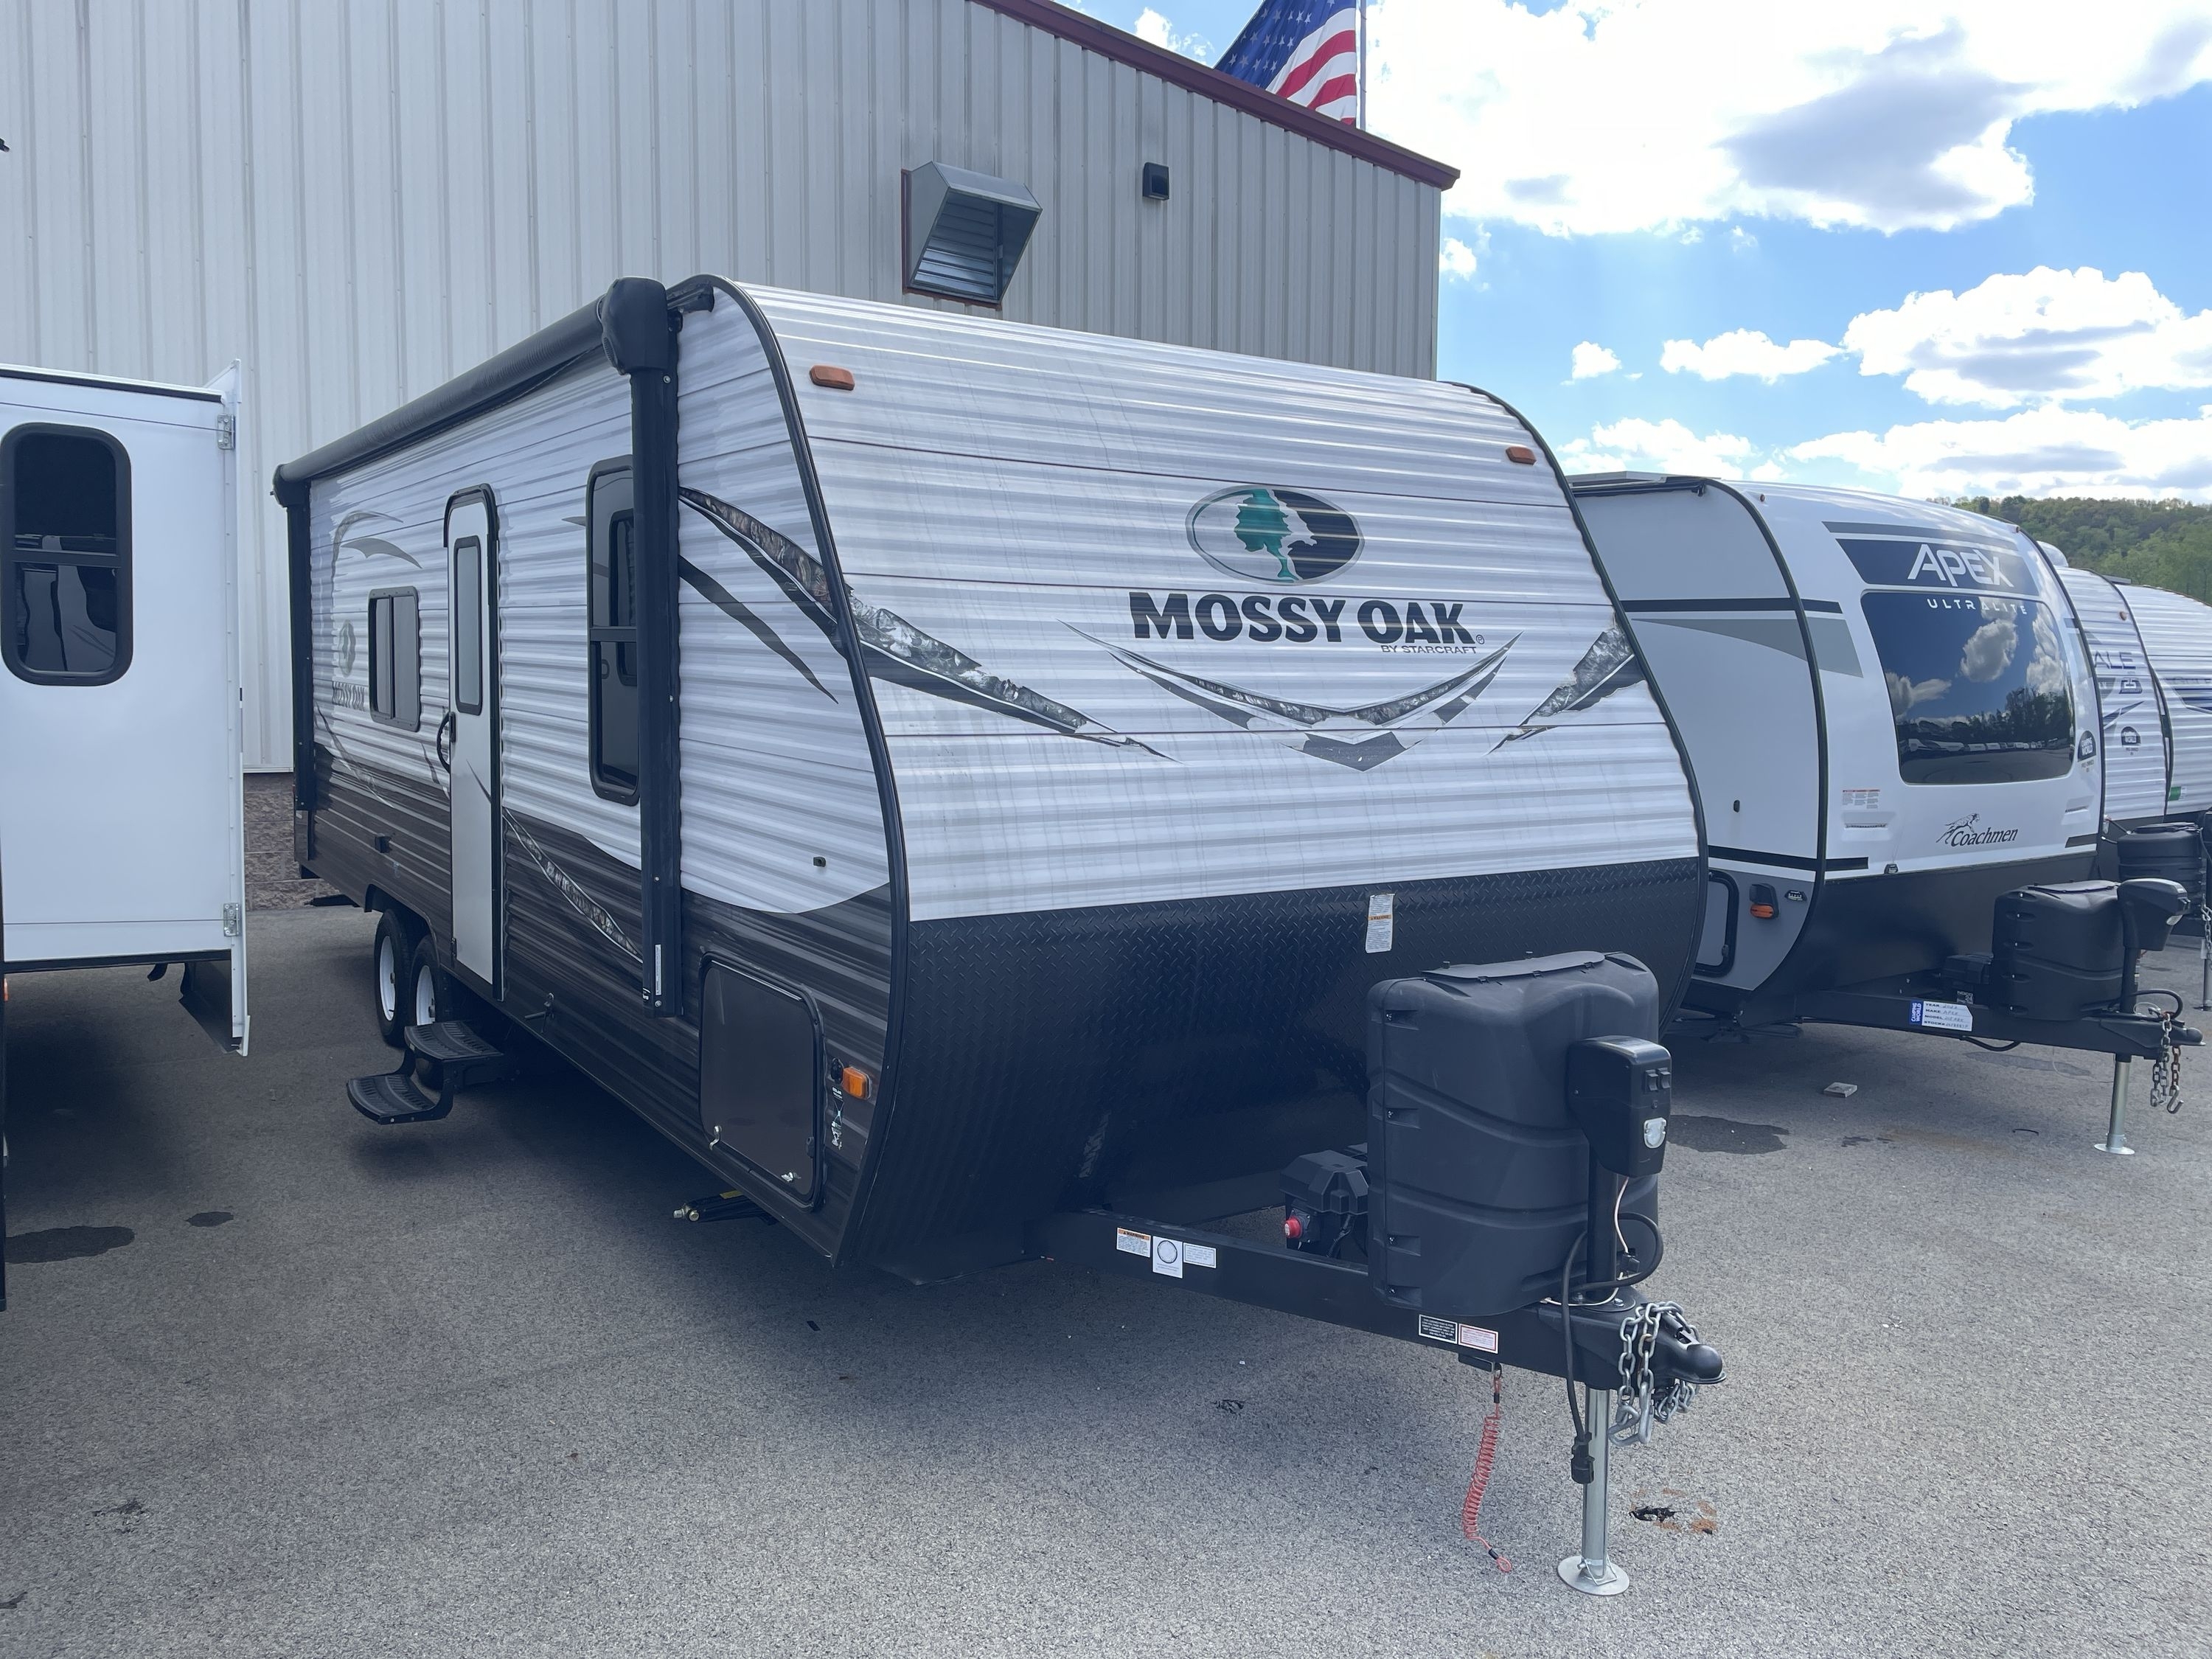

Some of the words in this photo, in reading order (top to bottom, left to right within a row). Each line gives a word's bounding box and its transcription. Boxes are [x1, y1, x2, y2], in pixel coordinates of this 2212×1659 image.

[1907, 544, 2014, 587] APEX
[1129, 592, 1346, 644] MOSSY
[1357, 599, 1477, 645] OAK
[1402, 646, 1477, 654] STARCRAFT
[1951, 827, 2019, 847] Coachmen
